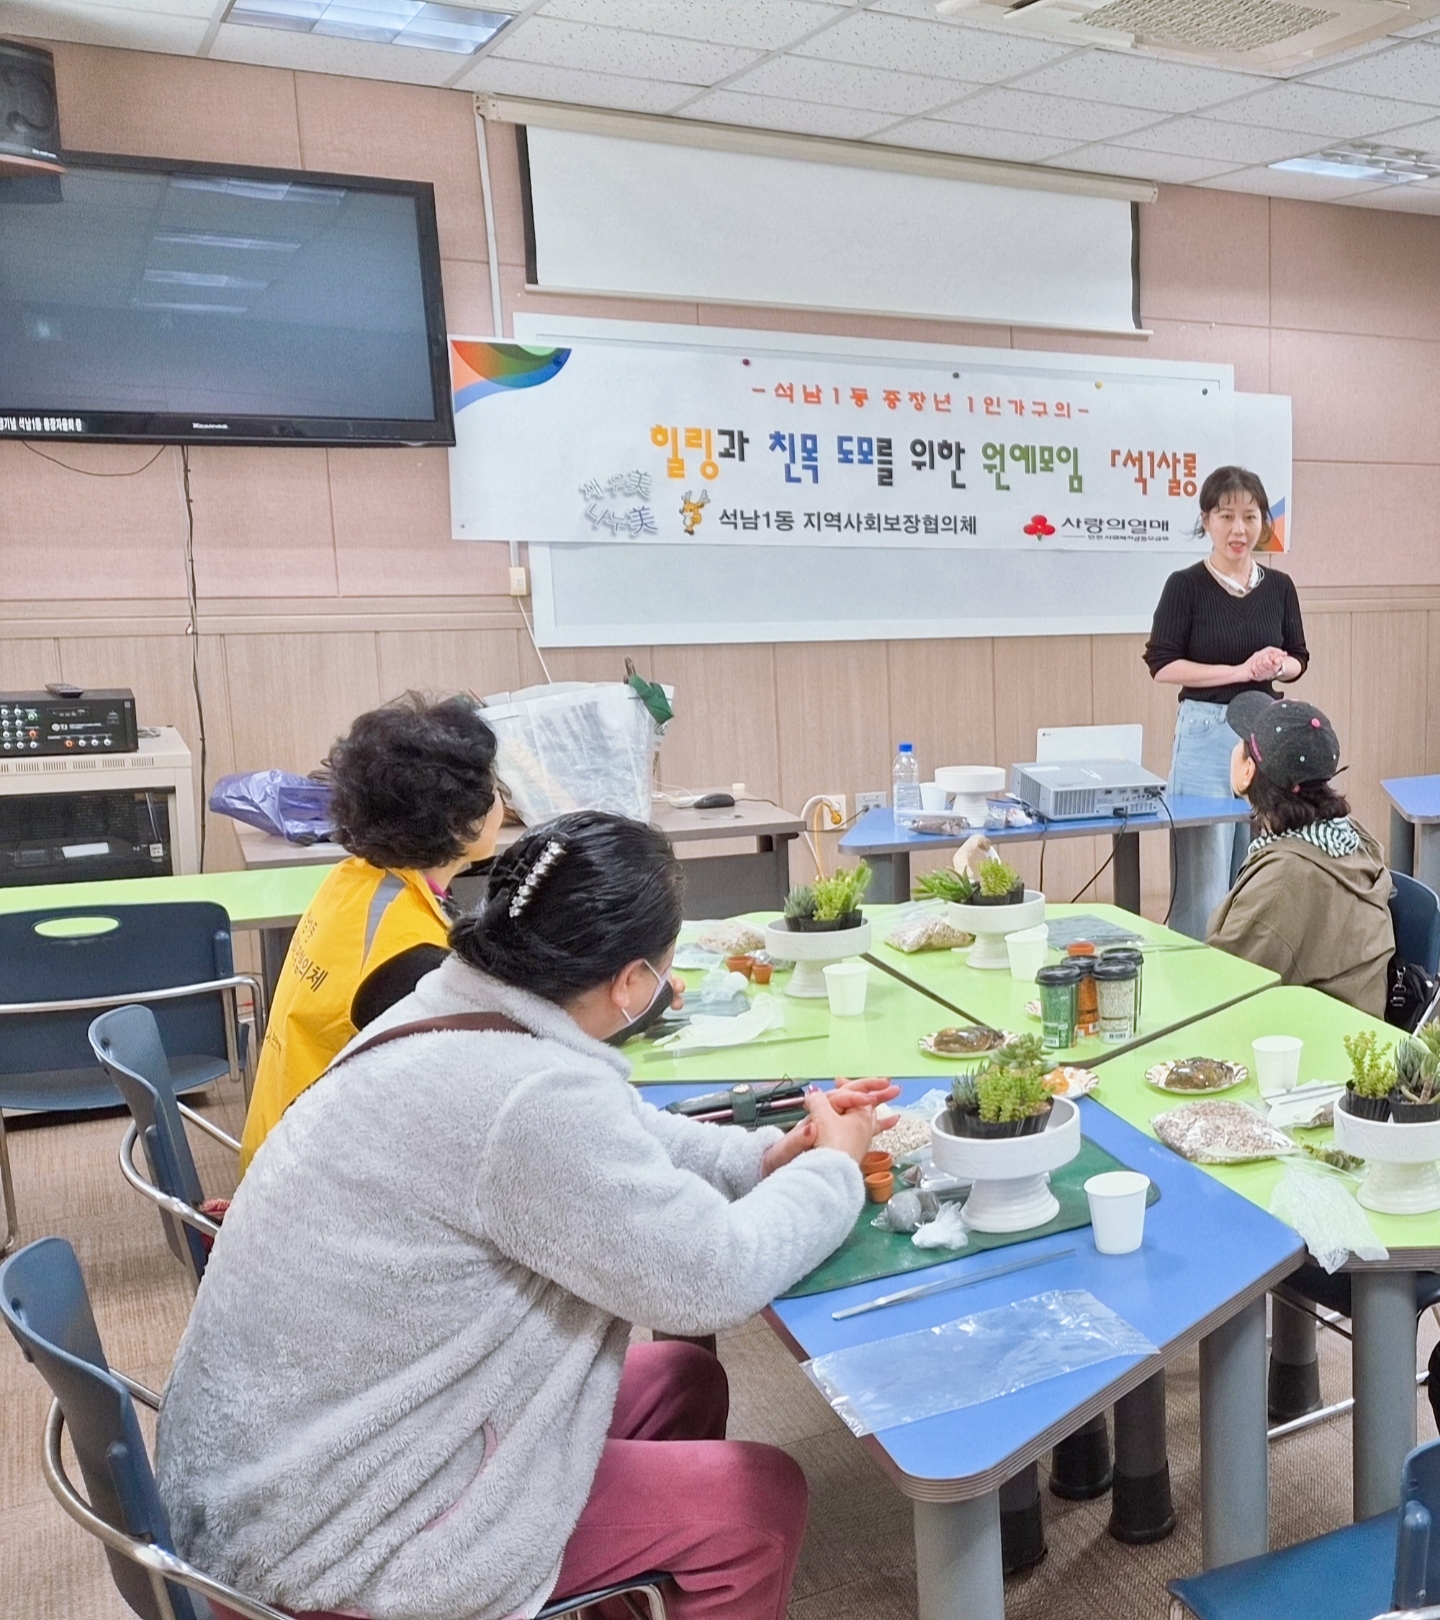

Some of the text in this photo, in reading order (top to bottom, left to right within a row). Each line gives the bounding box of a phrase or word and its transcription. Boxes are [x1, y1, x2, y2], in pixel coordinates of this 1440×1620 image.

[650, 424, 750, 481] 힐링과
[768, 430, 819, 484] 친목
[836, 434, 894, 487] 도모를
[909, 438, 966, 489] 위한
[981, 441, 1083, 493] 원예모임
[718, 508, 978, 535] 석남1동 지역사회보장협의체
[1061, 517, 1169, 535] 사랑의열매
